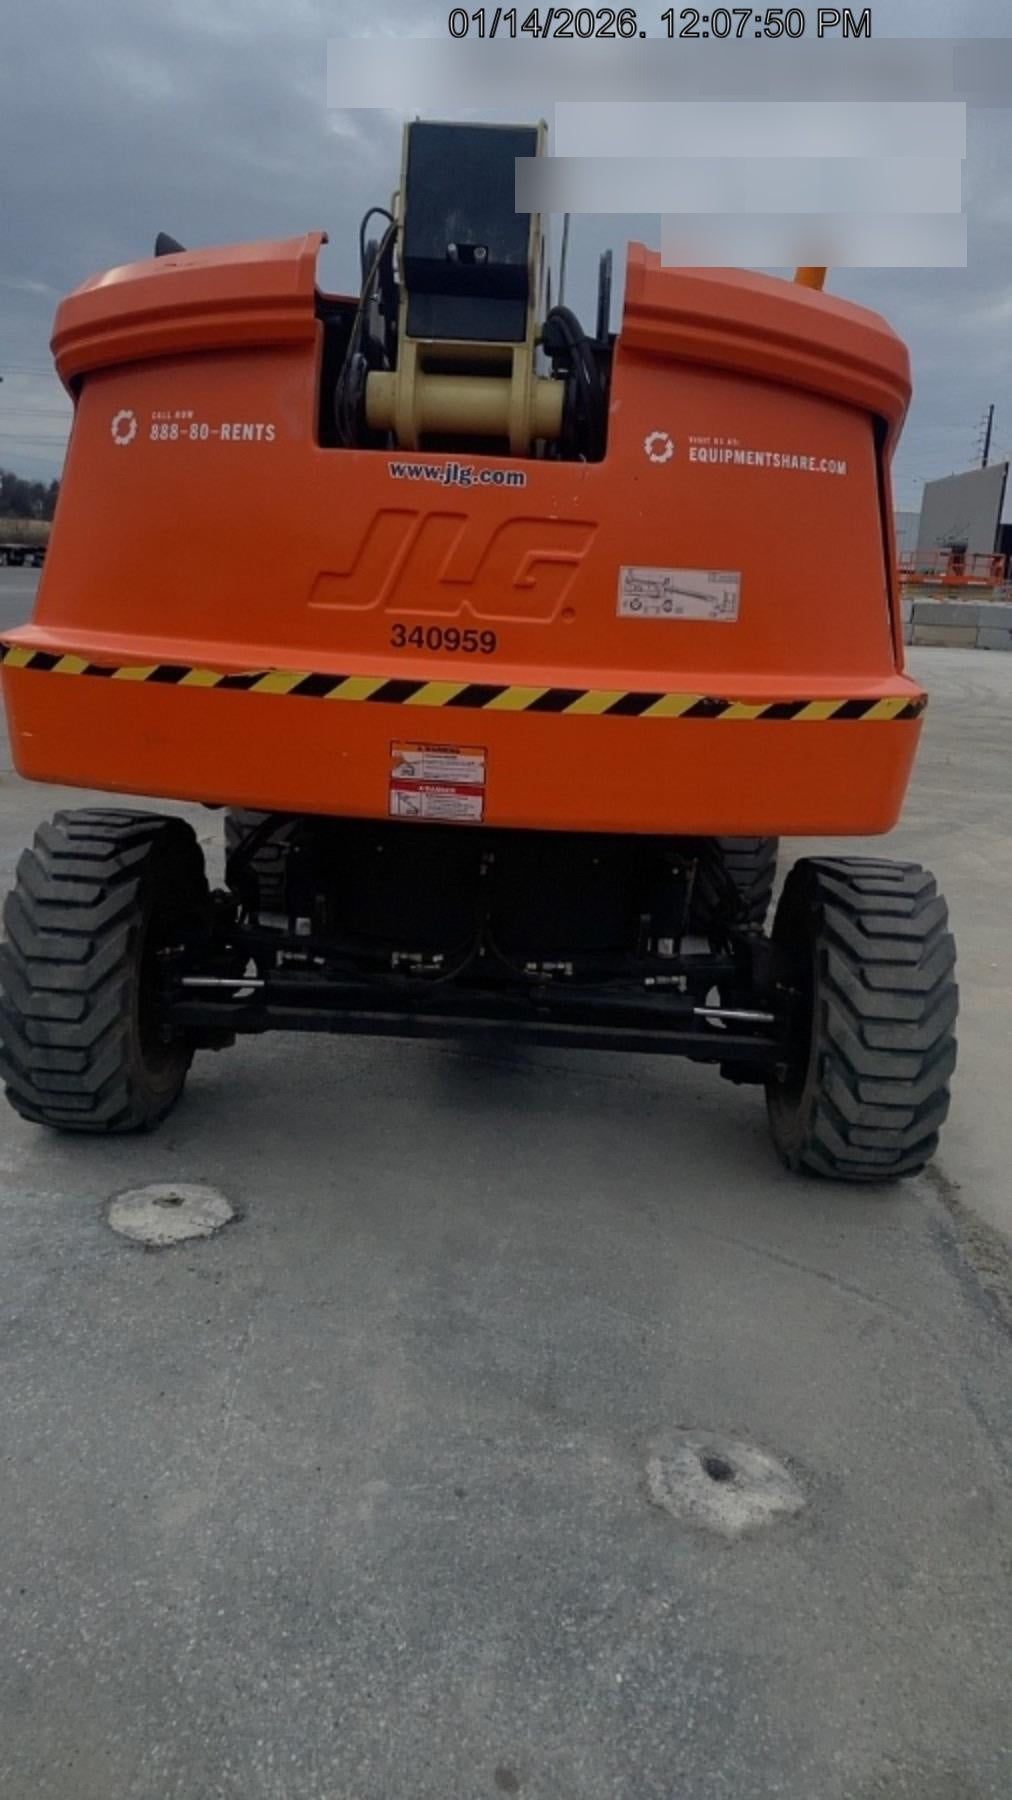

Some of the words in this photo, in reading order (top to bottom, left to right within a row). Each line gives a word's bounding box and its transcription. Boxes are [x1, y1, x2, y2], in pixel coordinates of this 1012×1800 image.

[151, 411, 171, 420] CALL
[175, 411, 194, 419] NOW
[150, 423, 276, 442] 888-80-RENTS
[689, 447, 847, 475] EQUIPMENTSHARE.COM
[389, 462, 527, 486] www.jlg.com
[390, 623, 497, 654] 340959
